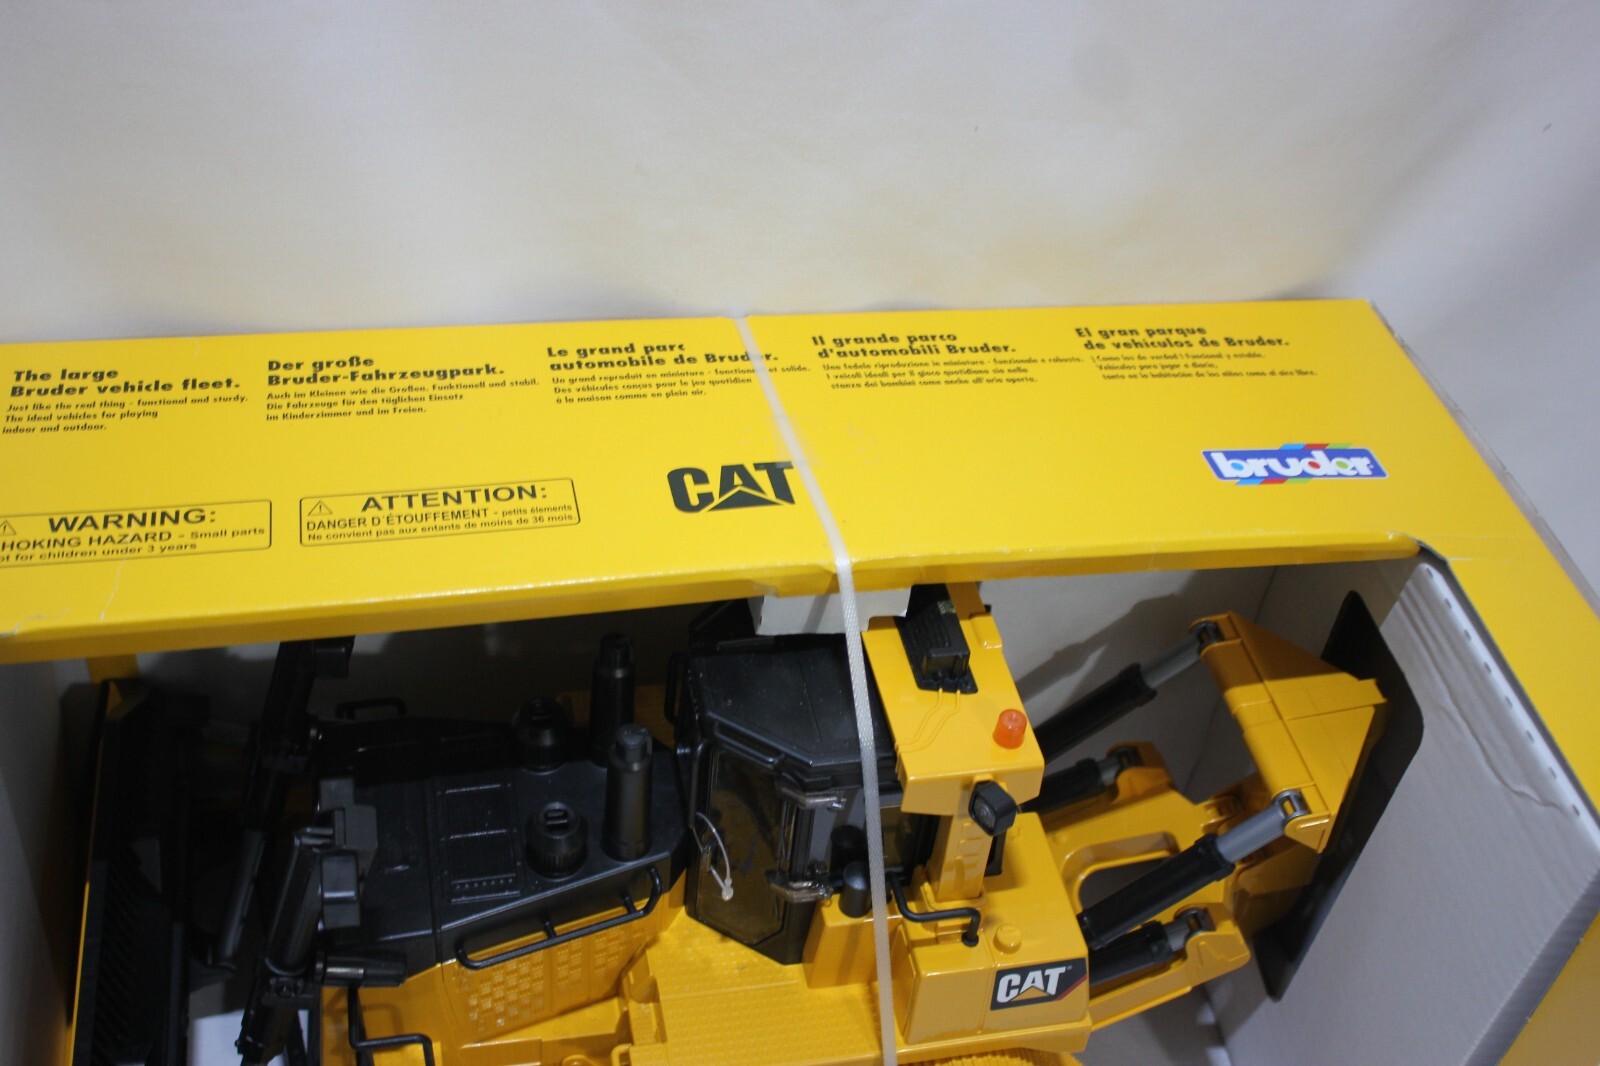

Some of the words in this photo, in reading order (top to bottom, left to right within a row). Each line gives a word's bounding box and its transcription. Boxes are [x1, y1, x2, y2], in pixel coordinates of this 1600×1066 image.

[812, 335, 825, 346] Il
[832, 333, 900, 347] grande
[906, 334, 957, 345] parco
[1075, 327, 1092, 337] El
[1098, 328, 1139, 339] gran
[1145, 327, 1206, 338] parque
[1084, 340, 1106, 350] de
[1199, 337, 1220, 347] de
[1224, 335, 1289, 347] Bruder.
[547, 347, 568, 357] Le
[576, 343, 636, 358] grand
[644, 343, 685, 355] parc
[818, 344, 940, 358] d'automobili
[946, 342, 1016, 354] Bruder.
[268, 360, 304, 371] Der
[312, 355, 375, 372] große
[550, 355, 666, 371] automobile
[673, 354, 698, 364] de
[704, 351, 778, 363] Brudr.
[14, 370, 52, 382] The
[60, 369, 119, 382] large
[268, 364, 504, 386] Bruder-Fahrzeugpark.
[10, 384, 88, 397] Bruder
[97, 380, 173, 394] vehicle
[182, 378, 240, 390] fleet.
[267, 391, 290, 400] Auch
[309, 389, 346, 397] Kleinen
[371, 386, 386, 394] die
[389, 384, 428, 393] Großen.
[432, 381, 485, 391] Funktionell
[488, 380, 506, 388] und
[510, 378, 539, 387] stabil.
[7, 404, 29, 412] Just
[32, 403, 51, 411] like
[55, 402, 71, 410] the
[75, 401, 96, 409] real
[99, 400, 125, 409] thing
[137, 397, 188, 406] functional
[191, 396, 210, 404] and
[213, 394, 248, 403] sturdy.
[286, 401, 338, 409] Fahrzeuge
[342, 398, 356, 406] für
[381, 395, 425, 404] täglichen
[429, 393, 464, 402] Einsatz
[5, 415, 23, 423] The
[27, 413, 53, 422] ideal
[56, 412, 97, 421] vehicles
[101, 411, 116, 419] for
[119, 410, 158, 419] playing
[356, 408, 374, 416] und
[393, 406, 427, 414] Freien.
[2, 426, 36, 434] indoor
[40, 424, 60, 432] and
[62, 423, 107, 432] outdoor.
[1210, 450, 1373, 478] bruder
[667, 461, 796, 513] CAT
[361, 485, 547, 512] ATTENTION:
[48, 508, 216, 533] WARNING:
[306, 517, 367, 531] DANGER
[501, 507, 528, 517] petits
[308, 533, 322, 541] Ne
[326, 530, 373, 539] convient
[376, 529, 395, 538] pas
[464, 521, 477, 529] de
[480, 519, 513, 528] moins
[516, 517, 529, 525] de
[1, 537, 81, 551] HOKING
[89, 532, 172, 546] HAZARD
[190, 529, 227, 539] Small
[231, 528, 265, 538] parts
[0, 554, 10, 562] ot
[15, 553, 34, 561] for
[40, 549, 97, 560] children
[102, 546, 142, 555] under
[160, 543, 197, 553] years
[996, 966, 1066, 1003] CAT
